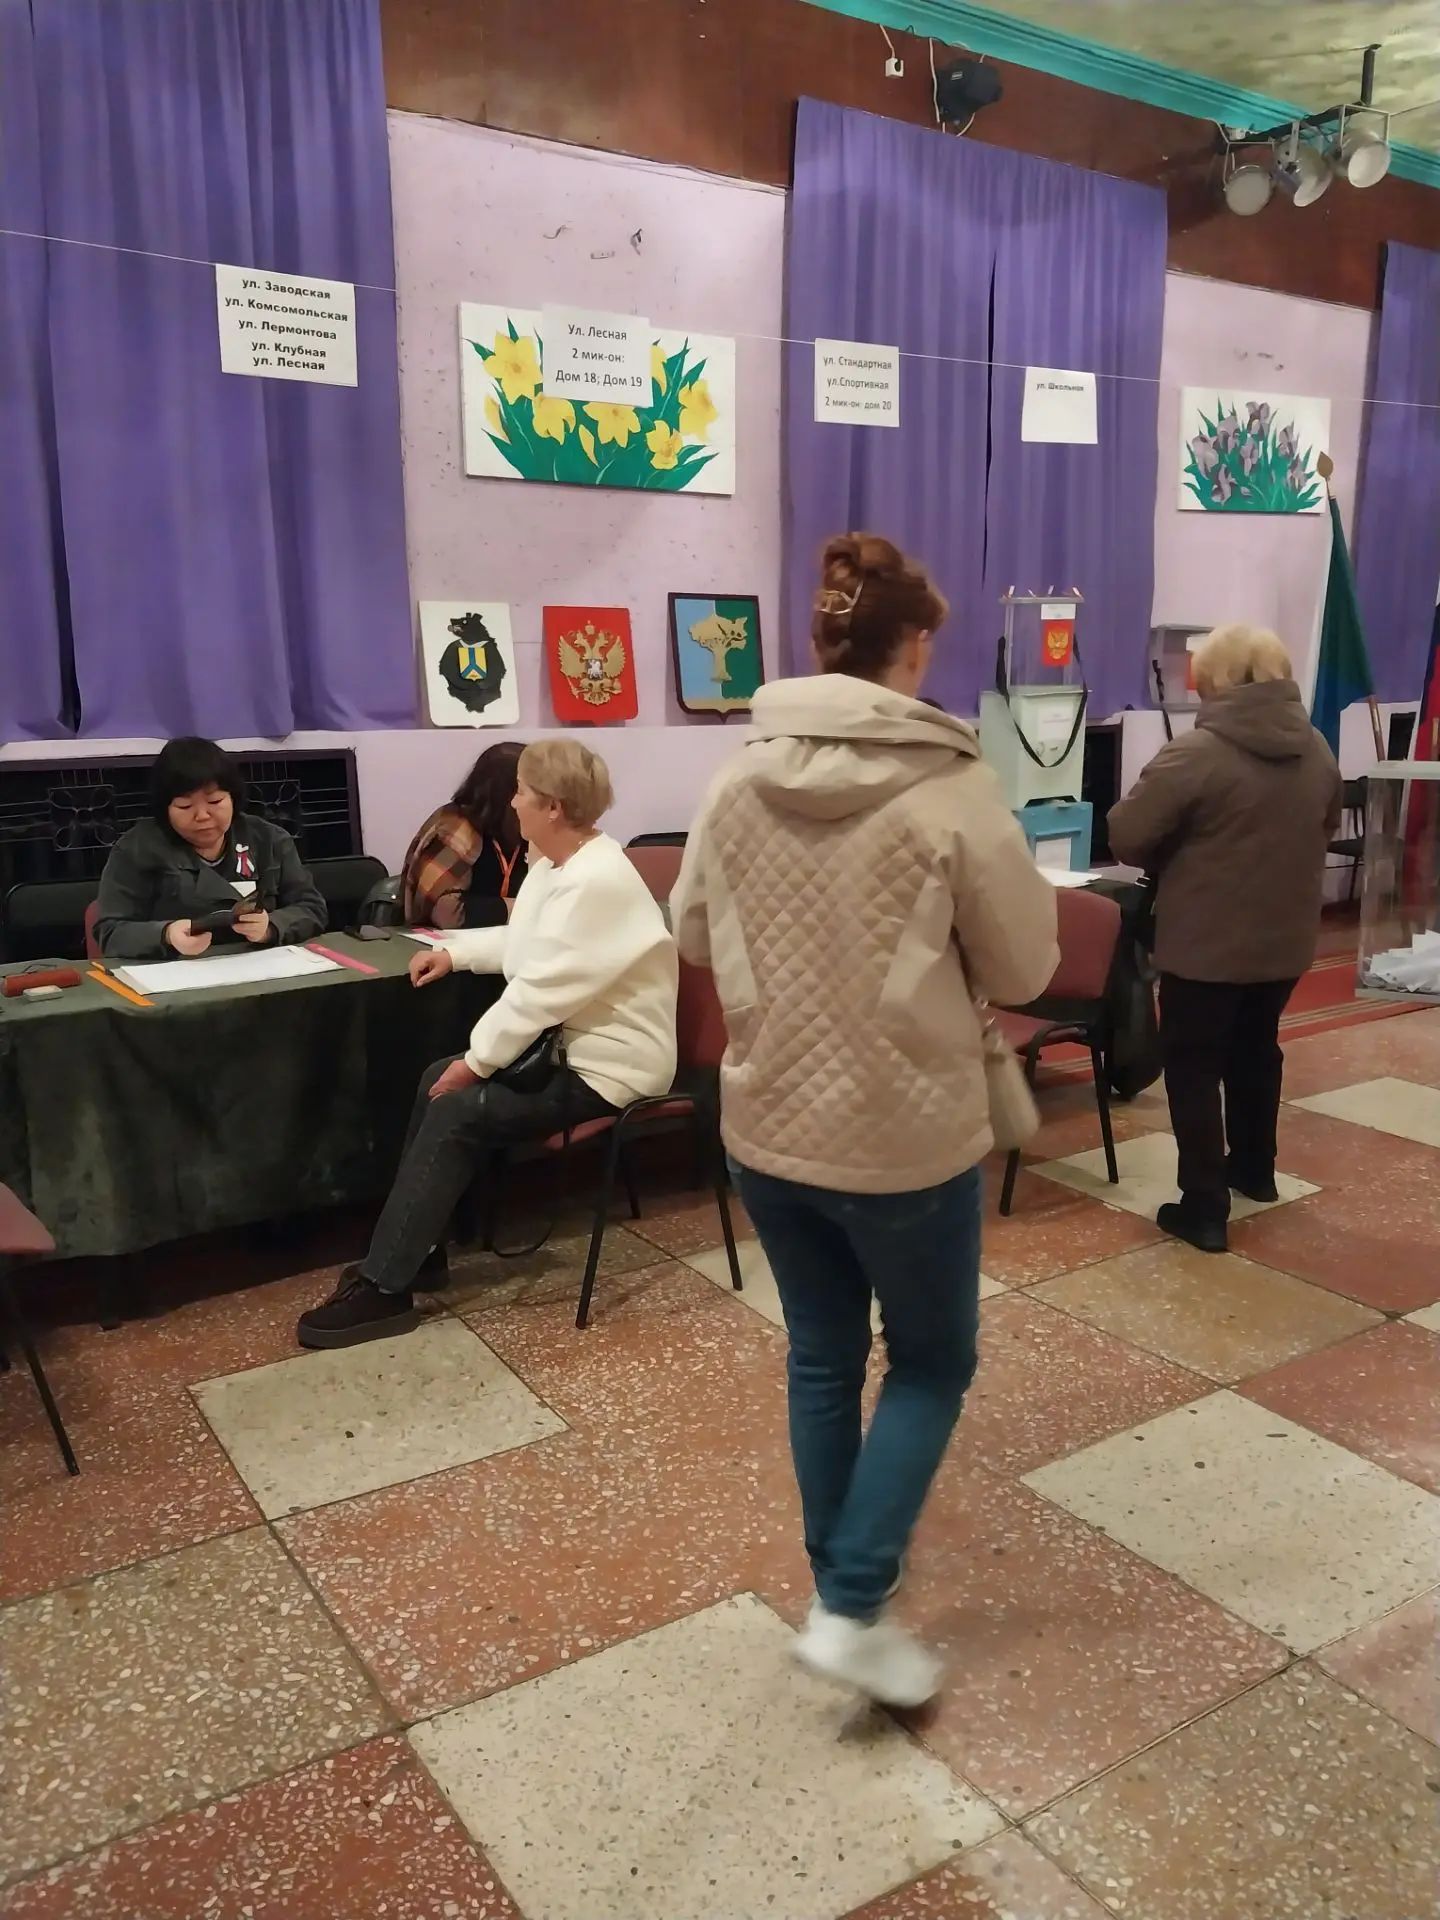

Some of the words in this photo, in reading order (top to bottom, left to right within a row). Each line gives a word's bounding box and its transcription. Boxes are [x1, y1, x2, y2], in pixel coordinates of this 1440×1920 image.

[242, 279, 260, 289] ул.
[265, 281, 331, 299] Заводская
[225, 297, 243, 307] ул.
[248, 299, 348, 321] Комсомольская
[239, 320, 257, 329] ул.
[261, 322, 336, 339] Лермонтова
[568, 324, 585, 336] Ул.
[588, 327, 627, 340] Лесная
[251, 342, 269, 351] ул.
[274, 343, 326, 357] Клубная
[572, 348, 578, 358] 2
[582, 351, 624, 362] мик-он:
[253, 357, 272, 366] ул.
[277, 358, 325, 370] Лесная
[824, 357, 836, 366] ул.
[839, 357, 892, 371] Стандартная
[556, 370, 580, 382] Дом
[585, 373, 600, 384] 18;
[603, 375, 627, 386] Дом
[631, 377, 642, 387] 19
[825, 397, 829, 406] 2
[882, 401, 891, 410] 20
